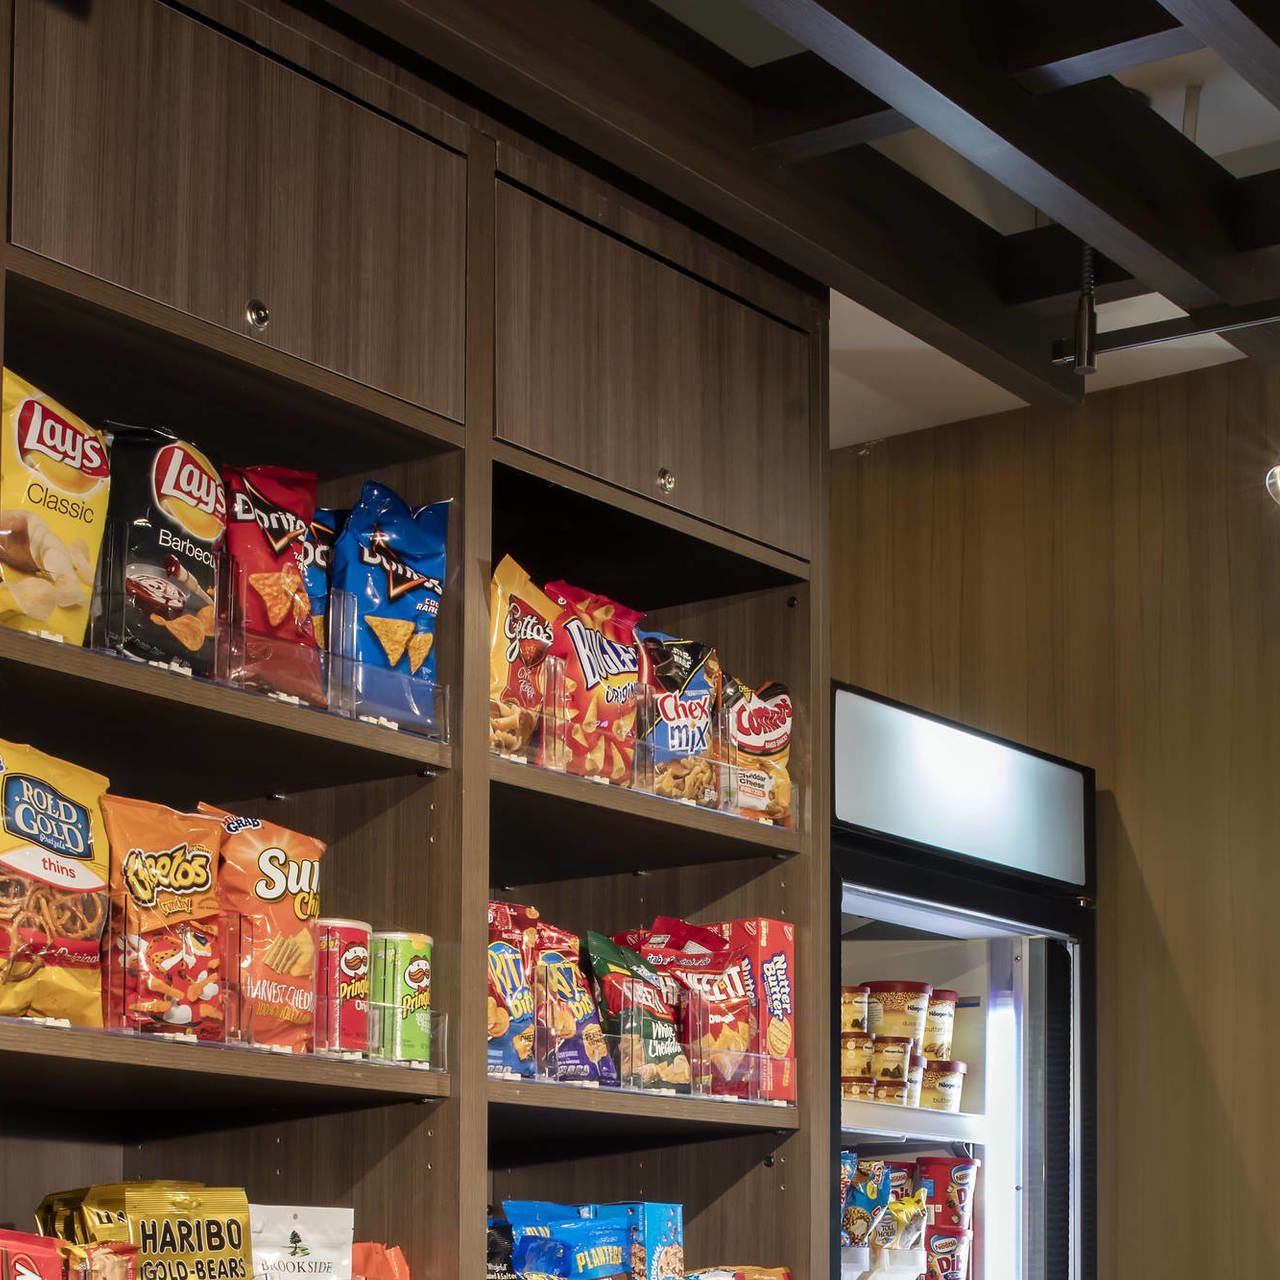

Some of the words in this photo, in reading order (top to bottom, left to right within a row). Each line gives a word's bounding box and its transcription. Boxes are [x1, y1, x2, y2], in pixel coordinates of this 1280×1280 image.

[24, 402, 101, 469] Lay's
[27, 483, 94, 524] Classic
[235, 493, 307, 542] Dorito
[158, 528, 217, 569] Barbecu
[659, 694, 708, 722] Chex
[670, 721, 708, 752] mix
[20, 778, 78, 824] ROLD
[14, 803, 84, 853] GOLD
[226, 816, 262, 833] GRAB
[41, 856, 77, 880] thins
[123, 842, 211, 907] Cheetos
[762, 960, 784, 1021] Butter
[773, 953, 792, 1016] Nutter
[140, 1218, 242, 1255] HARIBO
